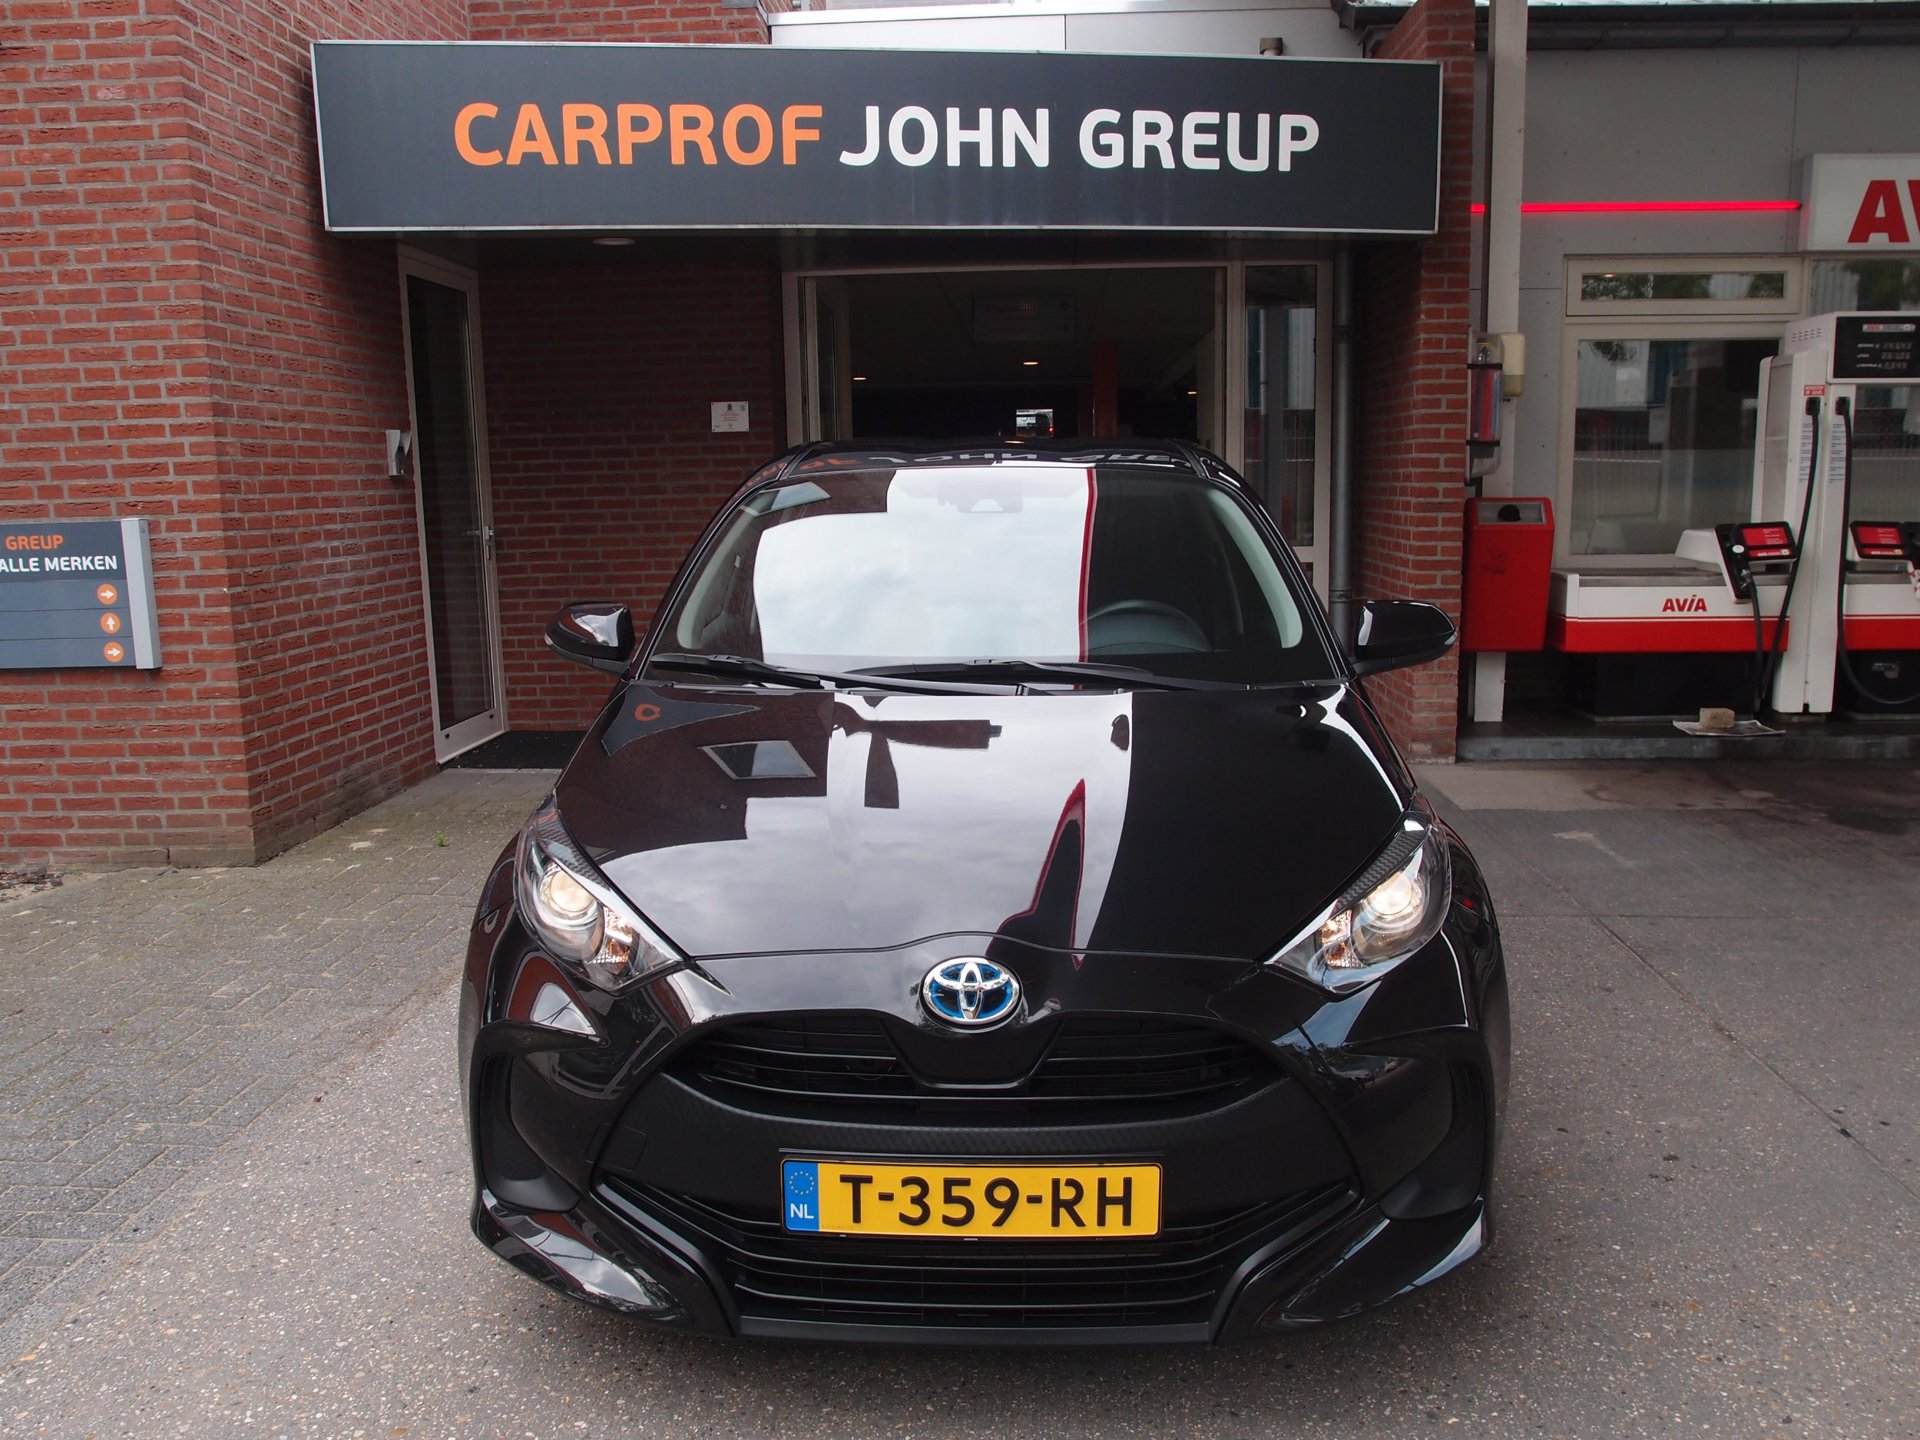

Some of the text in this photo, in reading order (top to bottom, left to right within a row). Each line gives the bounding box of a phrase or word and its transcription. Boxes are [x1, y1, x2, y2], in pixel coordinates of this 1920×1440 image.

[454, 102, 1320, 172] CARPROF JOHN GREUP
[1847, 179, 1920, 243] A
[5, 534, 64, 551] GREUP
[0, 555, 118, 573] ALLE MERKEN
[790, 1203, 815, 1219] NL
[839, 1173, 1133, 1228] T-359-RH
